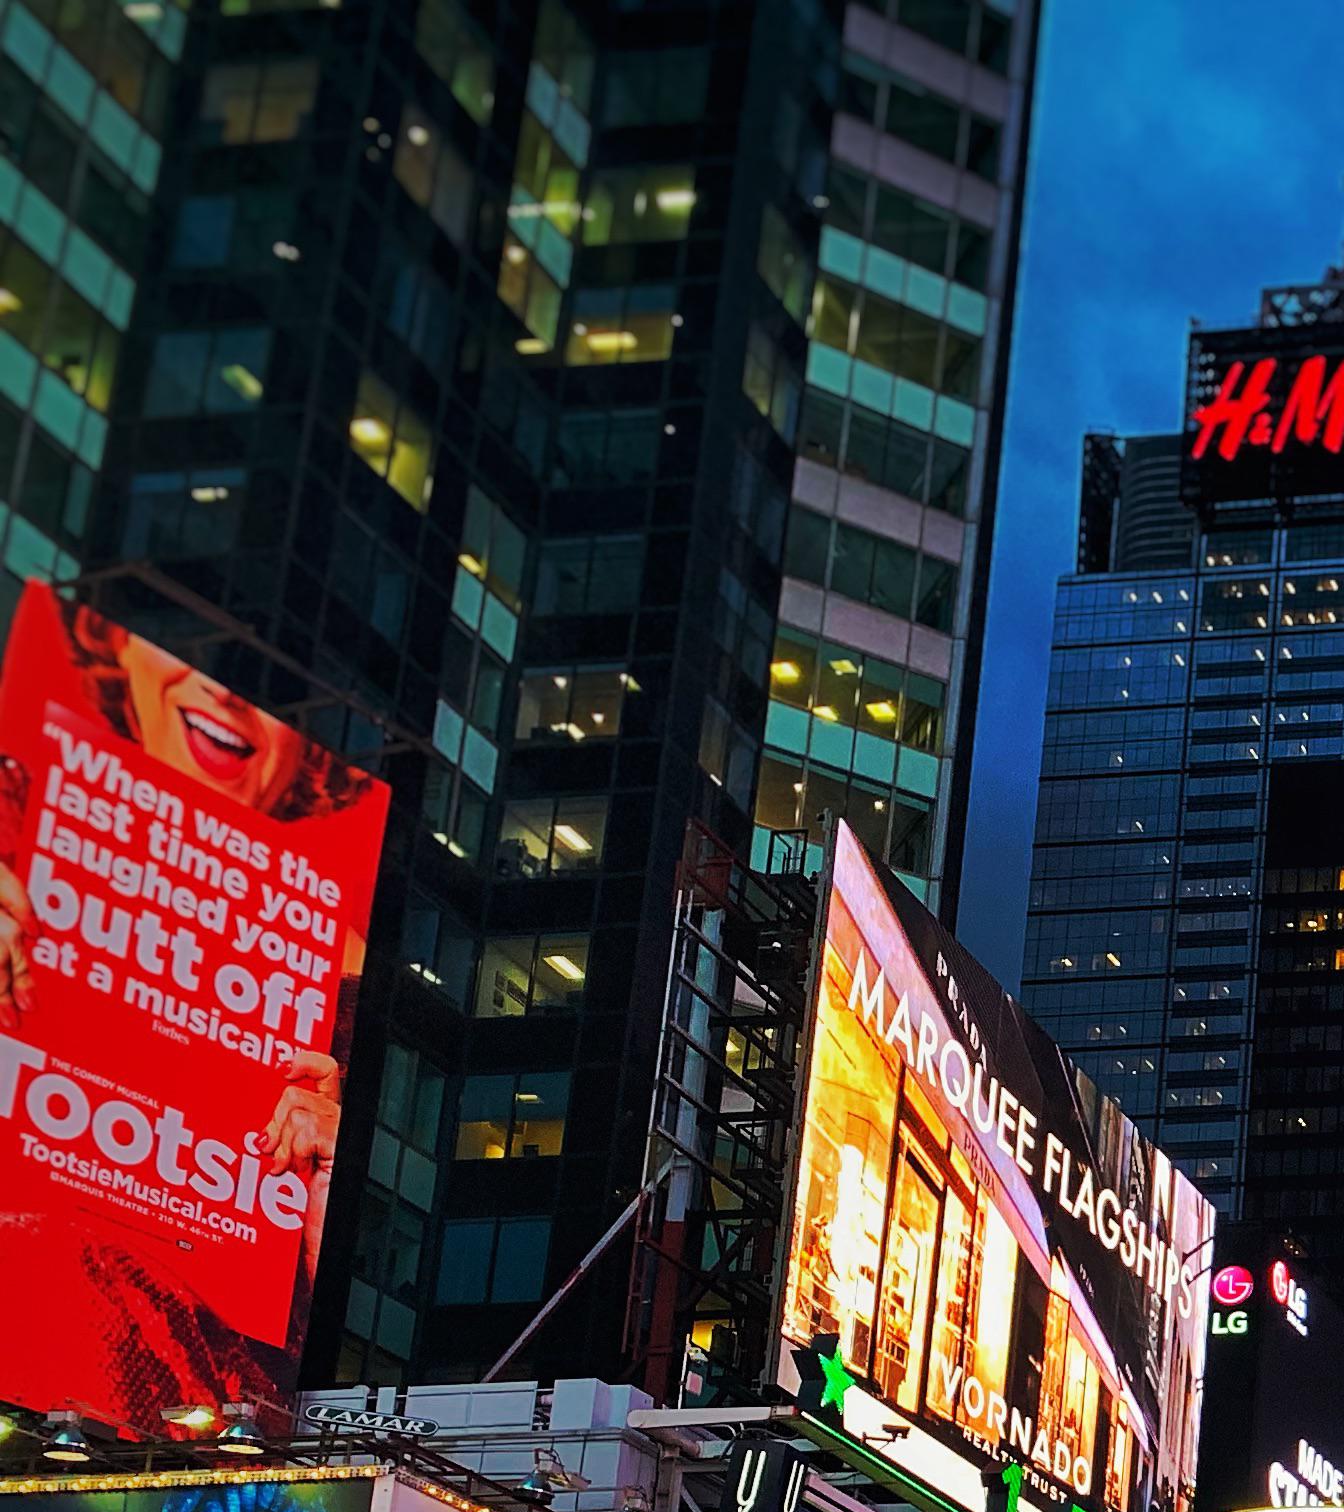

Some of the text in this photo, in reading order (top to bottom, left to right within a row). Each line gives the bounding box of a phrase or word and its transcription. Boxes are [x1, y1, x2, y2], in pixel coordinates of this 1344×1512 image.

[44, 765, 336, 947] last time you
[194, 808, 341, 908] was the
[36, 809, 332, 983] laughed your
[27, 852, 326, 1044] butt off
[32, 935, 79, 978] at
[87, 962, 113, 994] a
[152, 1020, 190, 1046] Forbes
[51, 1056, 159, 1110] THE COMEDY MUSICAL
[0, 1033, 309, 1231] Tootsie
[848, 946, 1194, 1322] MARQUEE FLAGSHIPS
[962, 1130, 998, 1201] PRADA
[19, 1133, 257, 1245] TootsieMusical.com
[107, 1191, 149, 1217] THEATRE
[1211, 1311, 1248, 1335] LG
[319, 1407, 425, 1433] LAMAR
[942, 1361, 1091, 1496] VORNADO
[1022, 1465, 1068, 1504] TRUST
[1298, 1438, 1343, 1506] MADE
